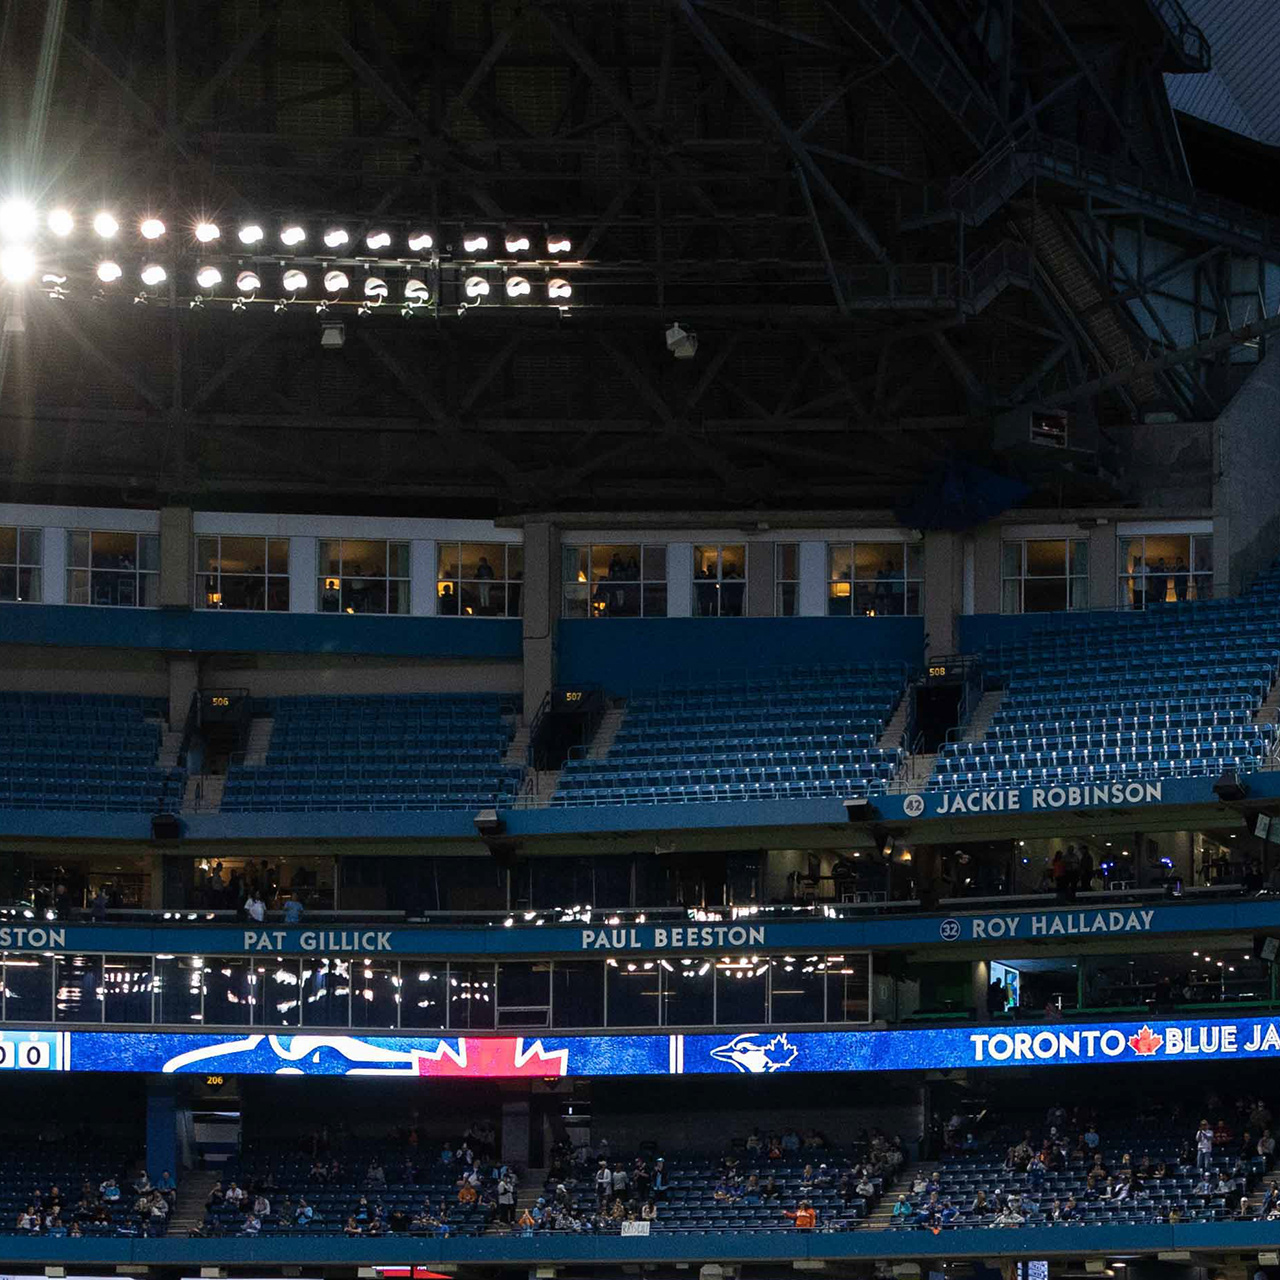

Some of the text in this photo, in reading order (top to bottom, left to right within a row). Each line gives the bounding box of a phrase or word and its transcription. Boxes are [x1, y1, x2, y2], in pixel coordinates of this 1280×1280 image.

[928, 666, 946, 677] 508
[212, 697, 229, 706] 506
[566, 692, 582, 702] 507
[937, 790, 1019, 813] JACKIE
[1033, 782, 1161, 808] ROBINSON
[942, 911, 1154, 937] 32 ROY HALLADAY
[245, 932, 391, 950] PAT GILLICK
[583, 927, 764, 948] PAUL BEESTON
[973, 1030, 1125, 1060] TORONTO
[1165, 1026, 1237, 1054] BLUE
[26, 1045, 41, 1066] 0
[206, 1076, 224, 1085] 206
